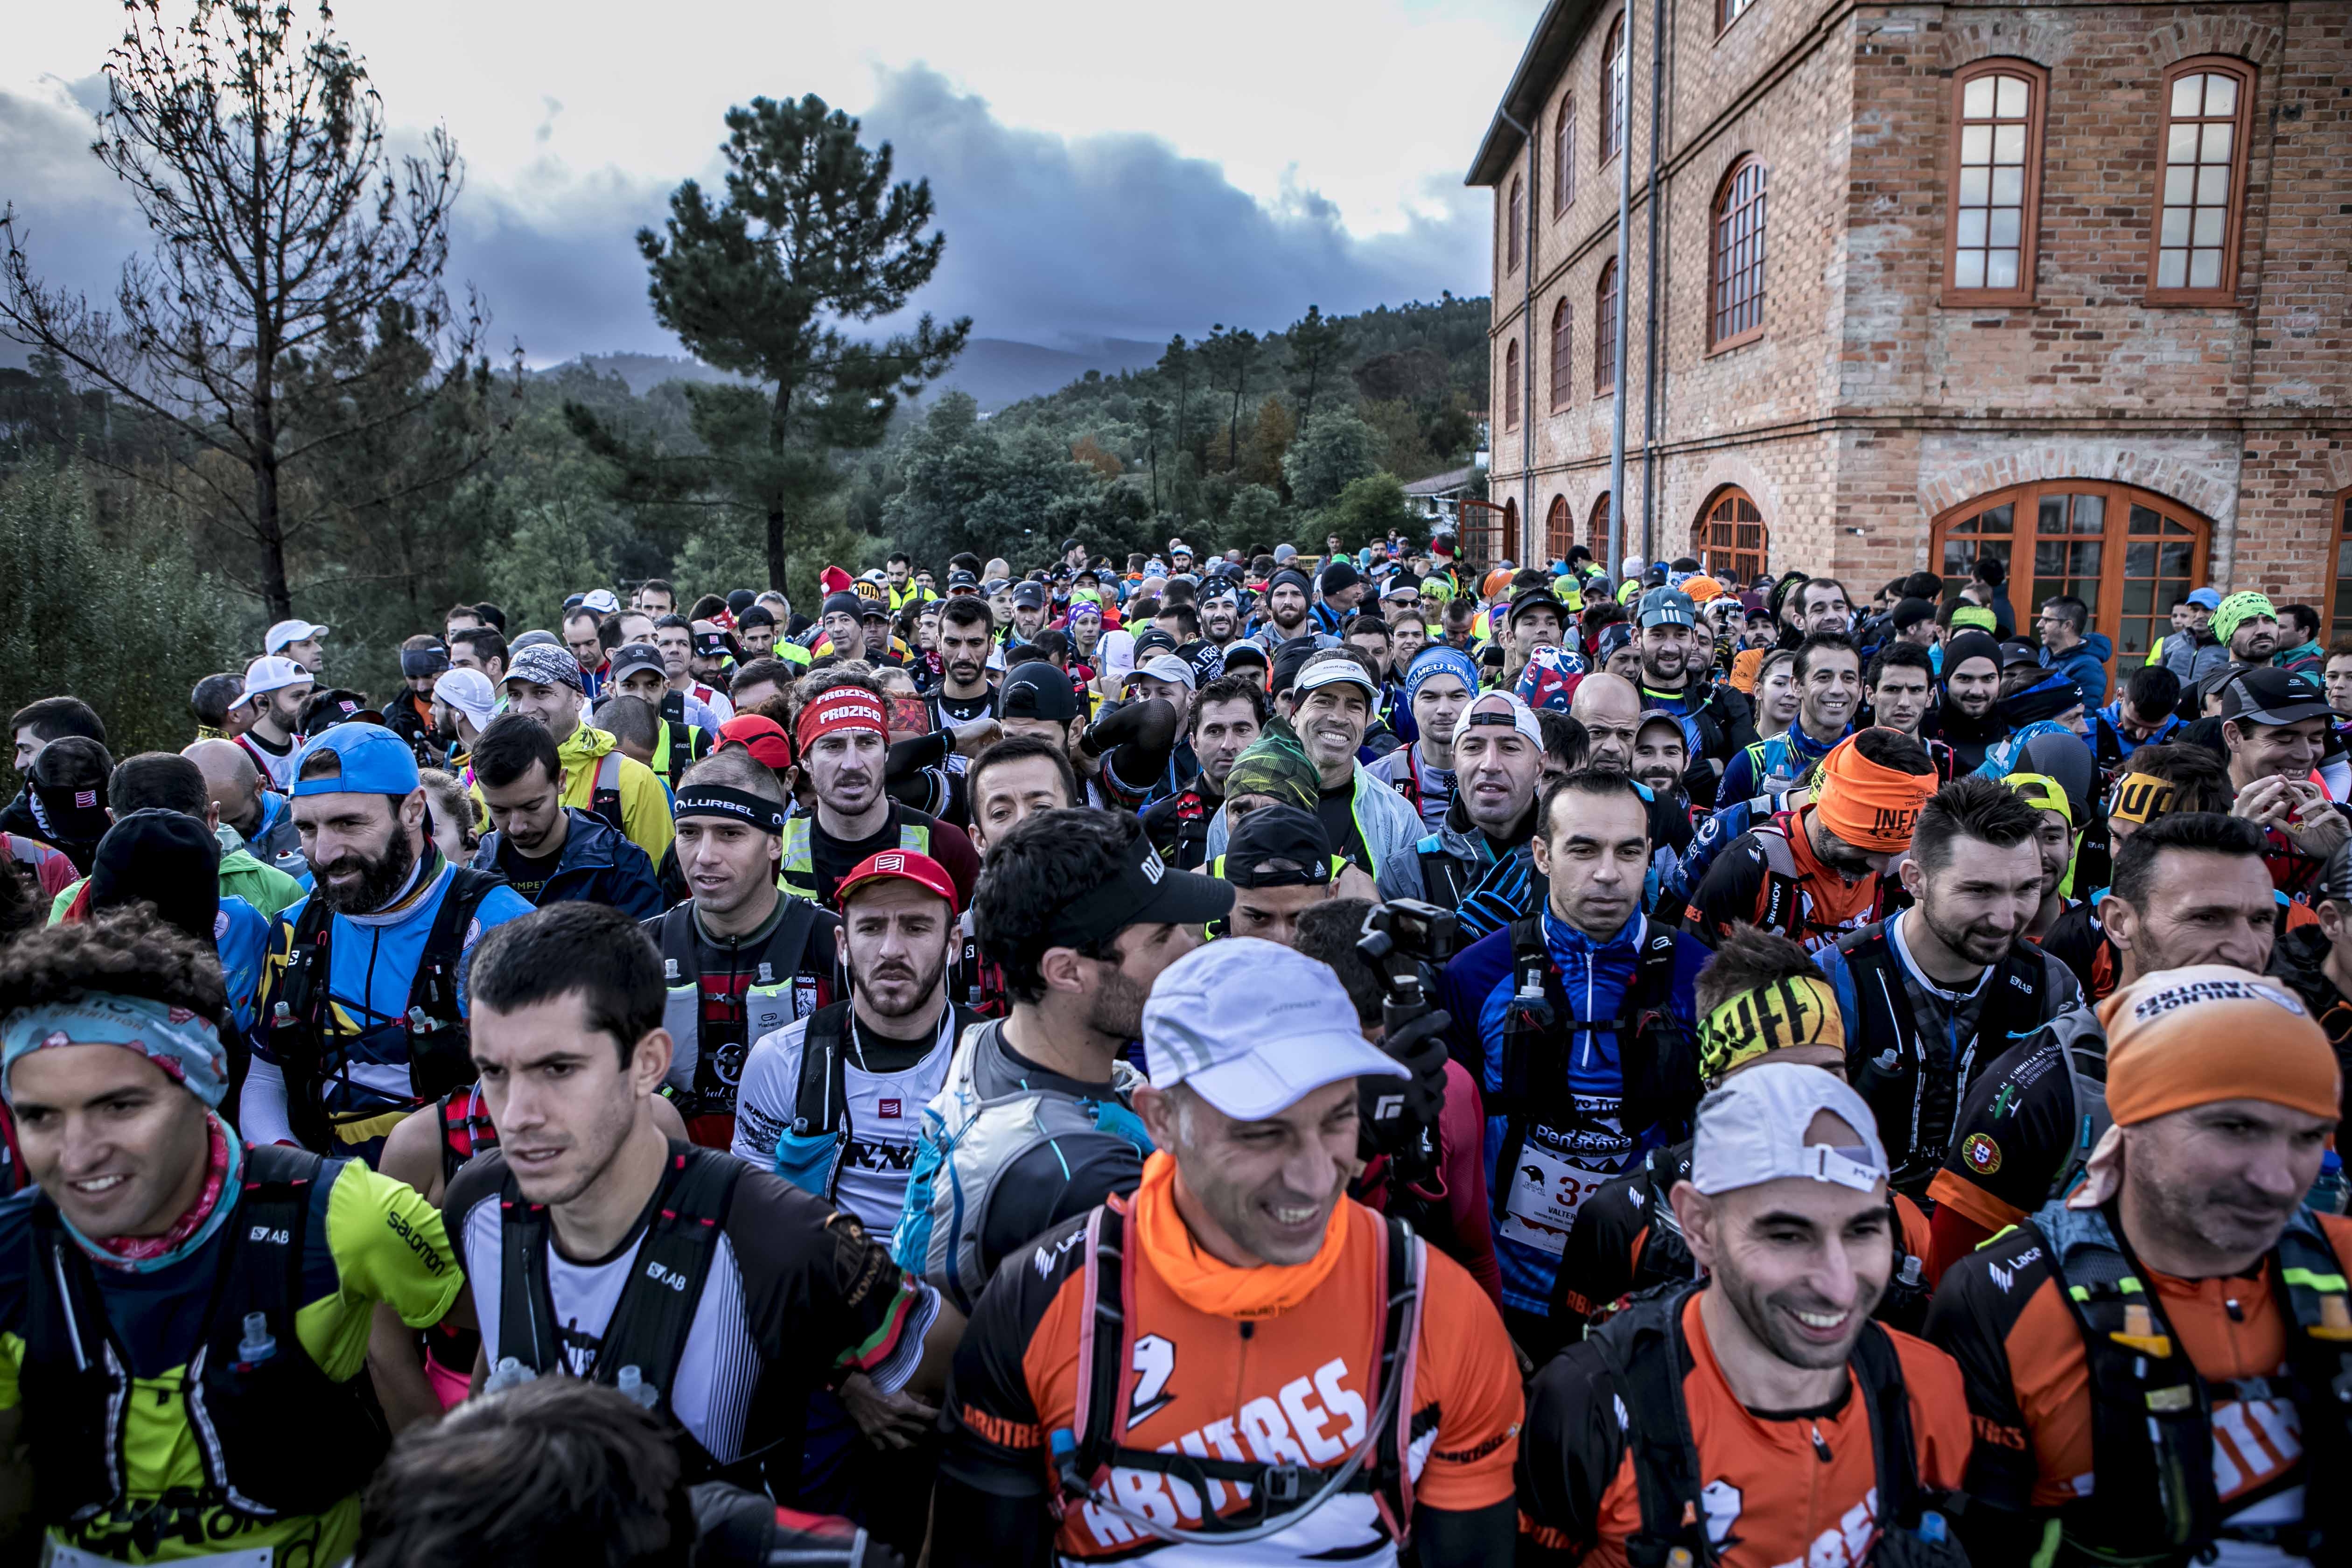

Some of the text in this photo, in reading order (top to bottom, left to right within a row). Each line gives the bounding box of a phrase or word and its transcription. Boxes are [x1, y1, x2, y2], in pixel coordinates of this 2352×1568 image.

[1418, 664, 1444, 680] MEU
[1447, 664, 1472, 688] DEUS
[688, 799, 755, 817] LURBEL
[1535, 1124, 1632, 1152] Penacova
[1548, 1205, 1576, 1220] VALTER
